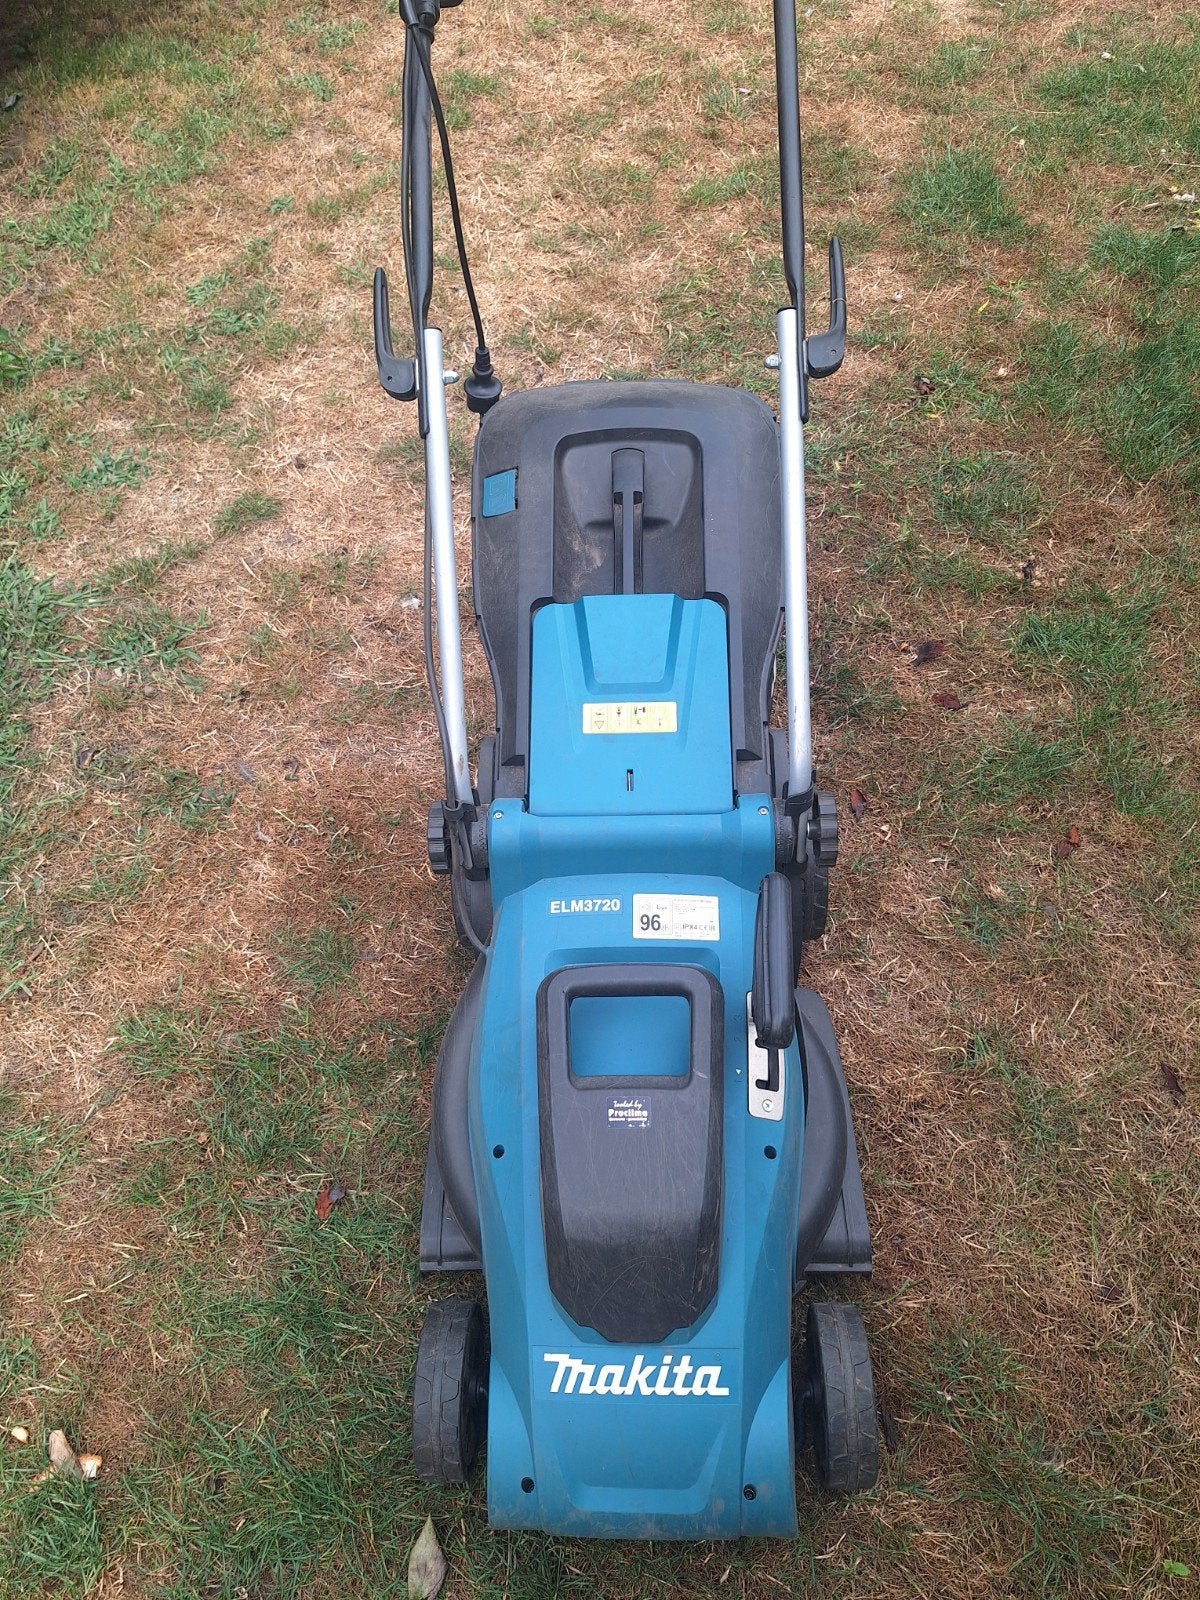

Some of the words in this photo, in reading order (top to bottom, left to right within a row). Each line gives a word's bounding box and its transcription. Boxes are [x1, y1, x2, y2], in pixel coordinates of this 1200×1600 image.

[550, 898, 621, 914] ELM3720
[640, 914, 661, 931] 96
[608, 1108, 648, 1117] Proclima
[543, 1353, 730, 1396] Makita
